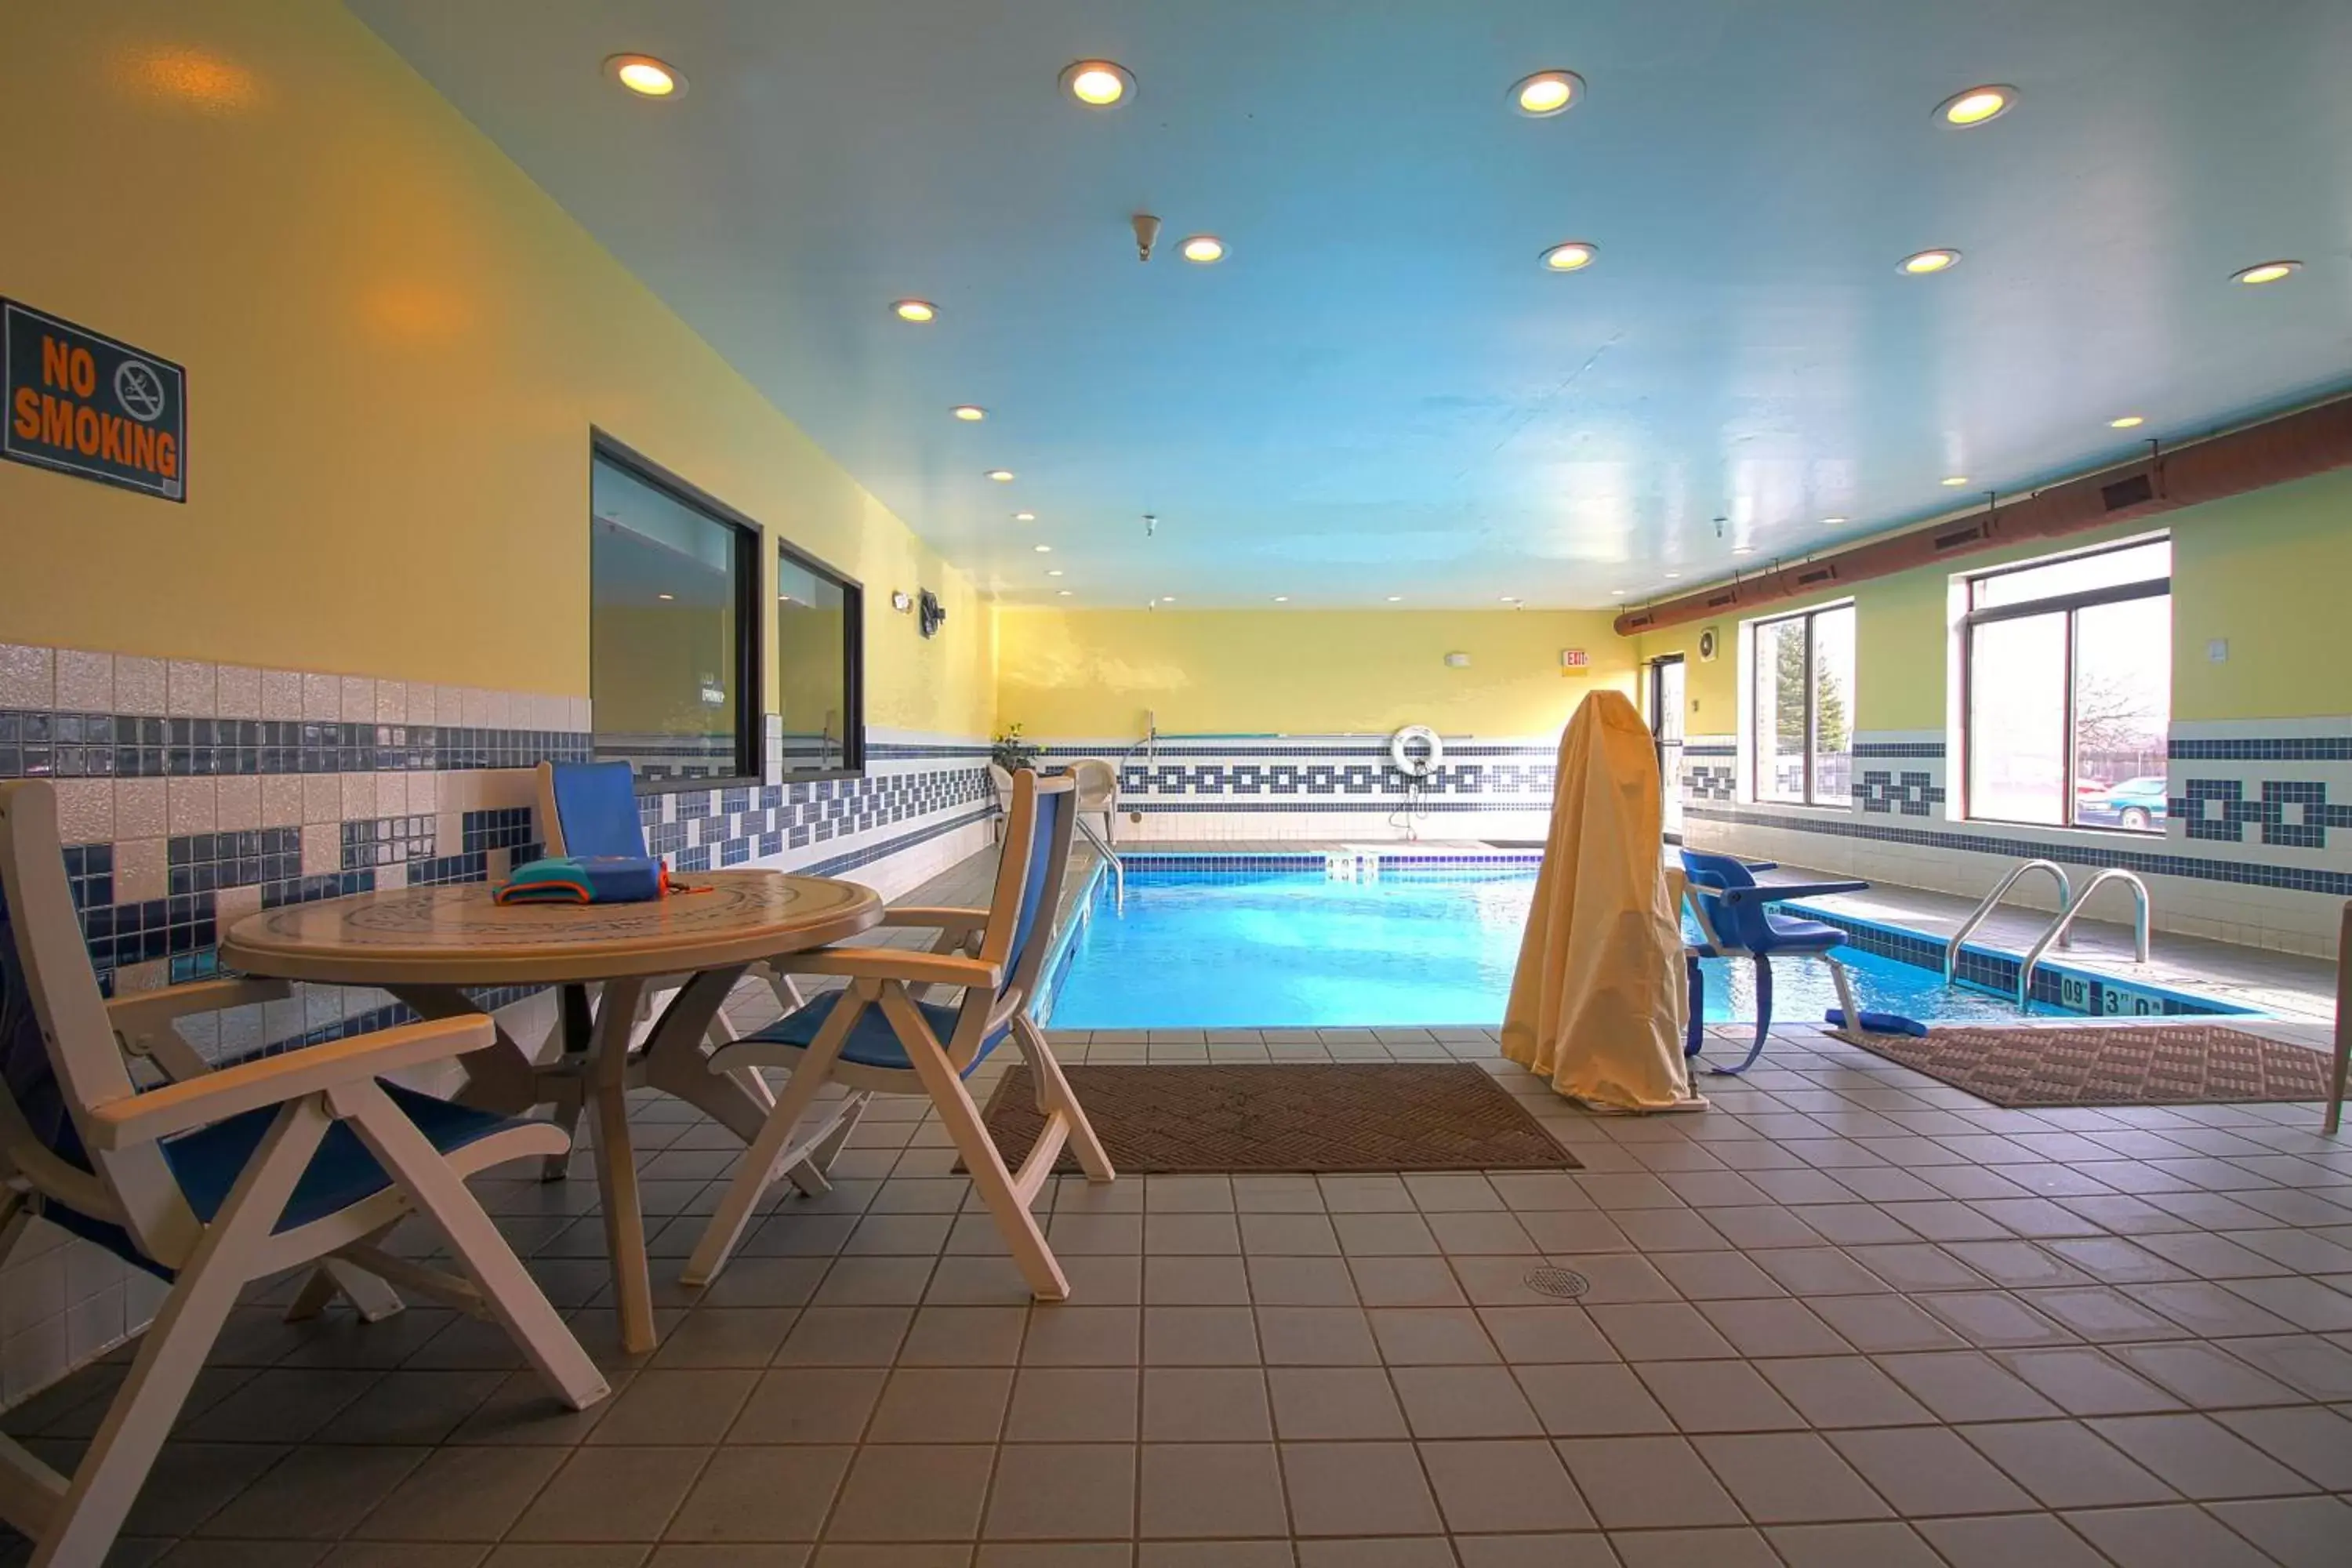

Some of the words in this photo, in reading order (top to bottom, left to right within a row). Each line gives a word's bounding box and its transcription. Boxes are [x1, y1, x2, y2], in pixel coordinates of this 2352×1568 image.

[43, 335, 96, 398] NO
[14, 387, 176, 478] SMOKING
[1568, 652, 1584, 665] EXIT
[2106, 991, 2118, 1013] 3
